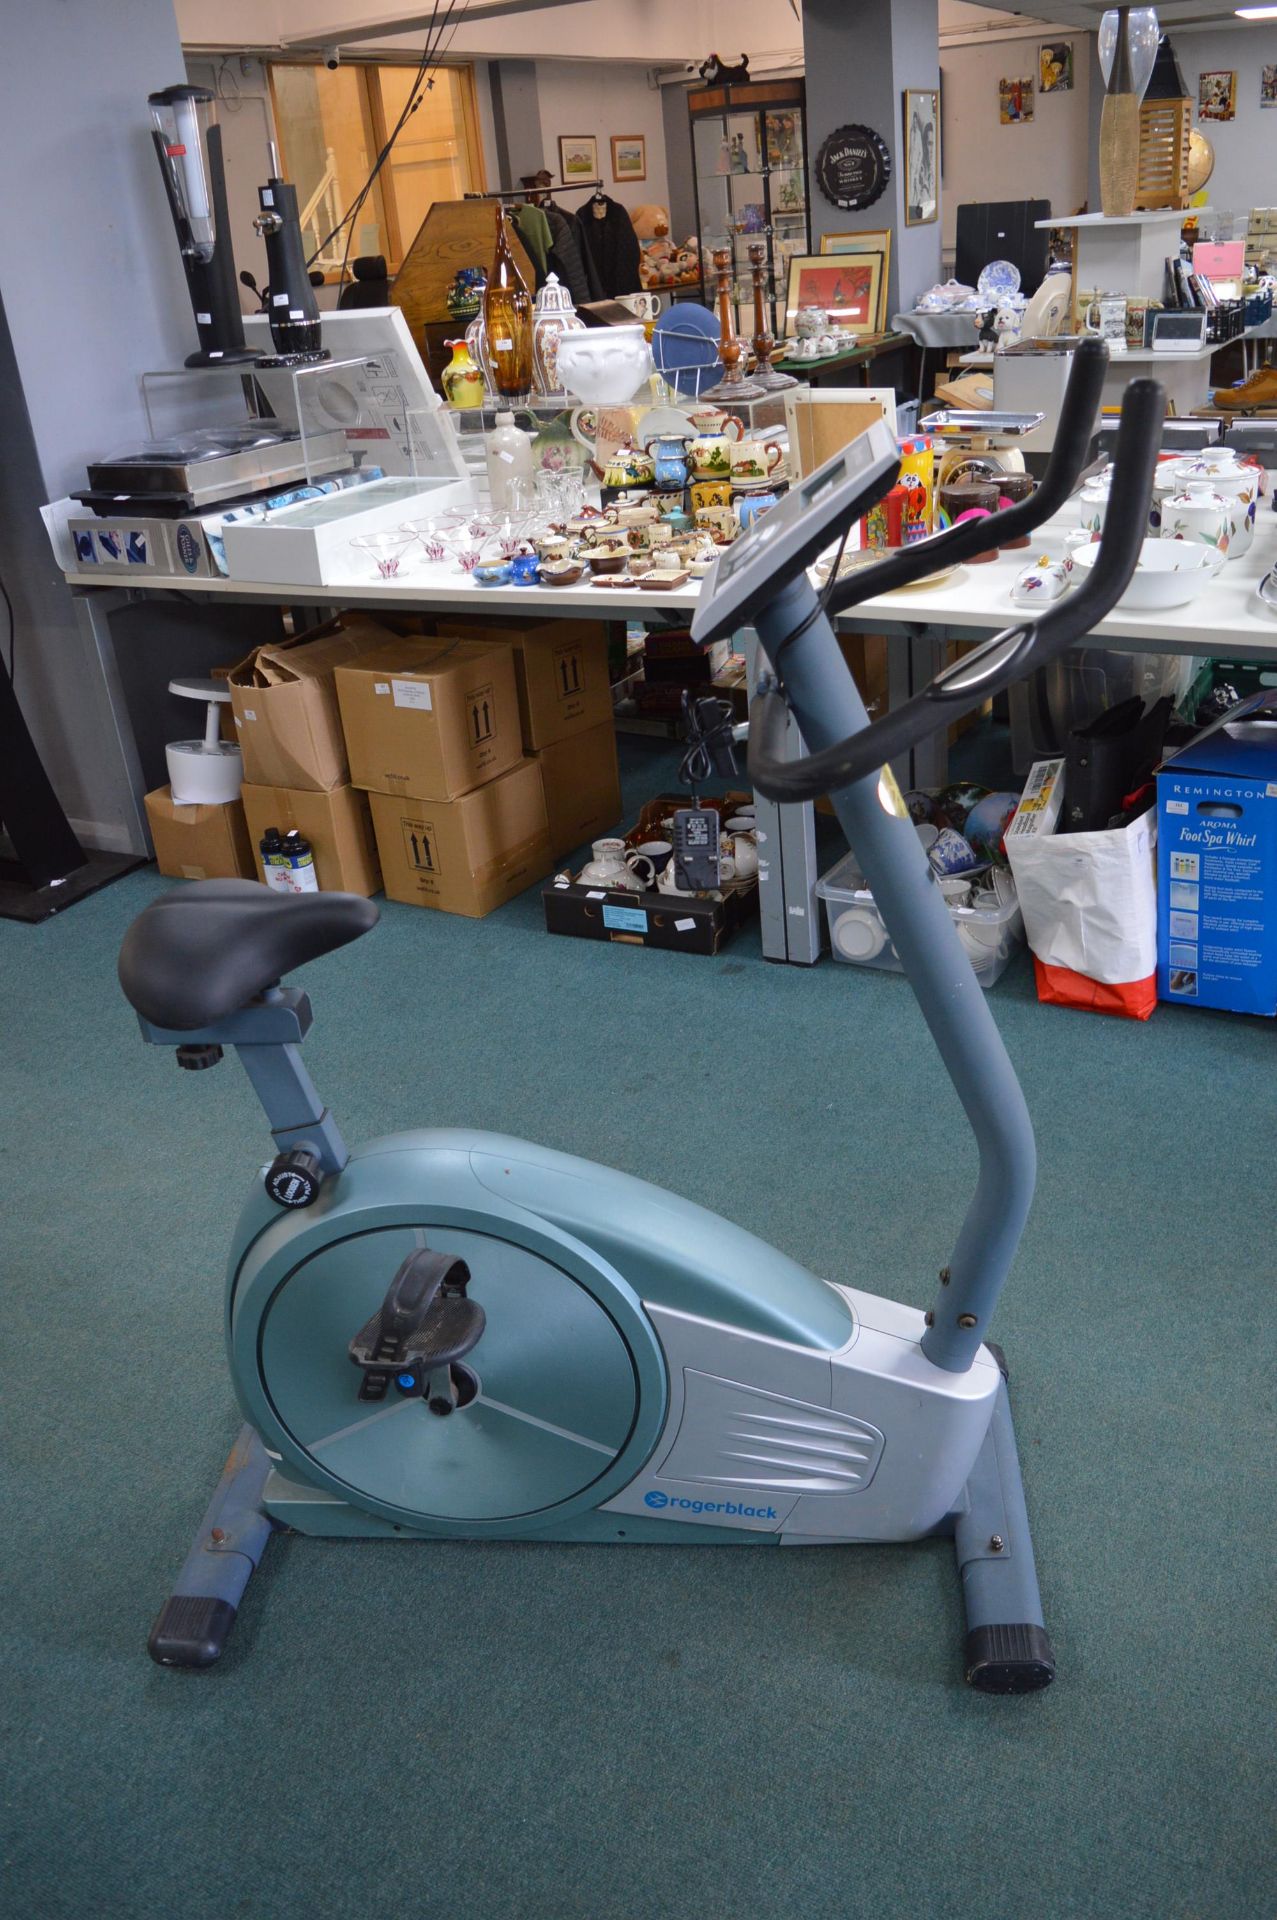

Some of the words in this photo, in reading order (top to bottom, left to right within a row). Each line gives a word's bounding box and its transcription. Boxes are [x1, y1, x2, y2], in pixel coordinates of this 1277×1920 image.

[1174, 785, 1265, 799] REMINGTON
[1199, 820, 1237, 829] AROMA
[1180, 827, 1202, 842] Foot
[1202, 829, 1223, 847] Spa
[1226, 831, 1257, 847] Whirl
[272, 1171, 292, 1186] ADJUST
[283, 1178, 301, 1200] LOOSEN
[670, 1497, 777, 1519] rogerblack
